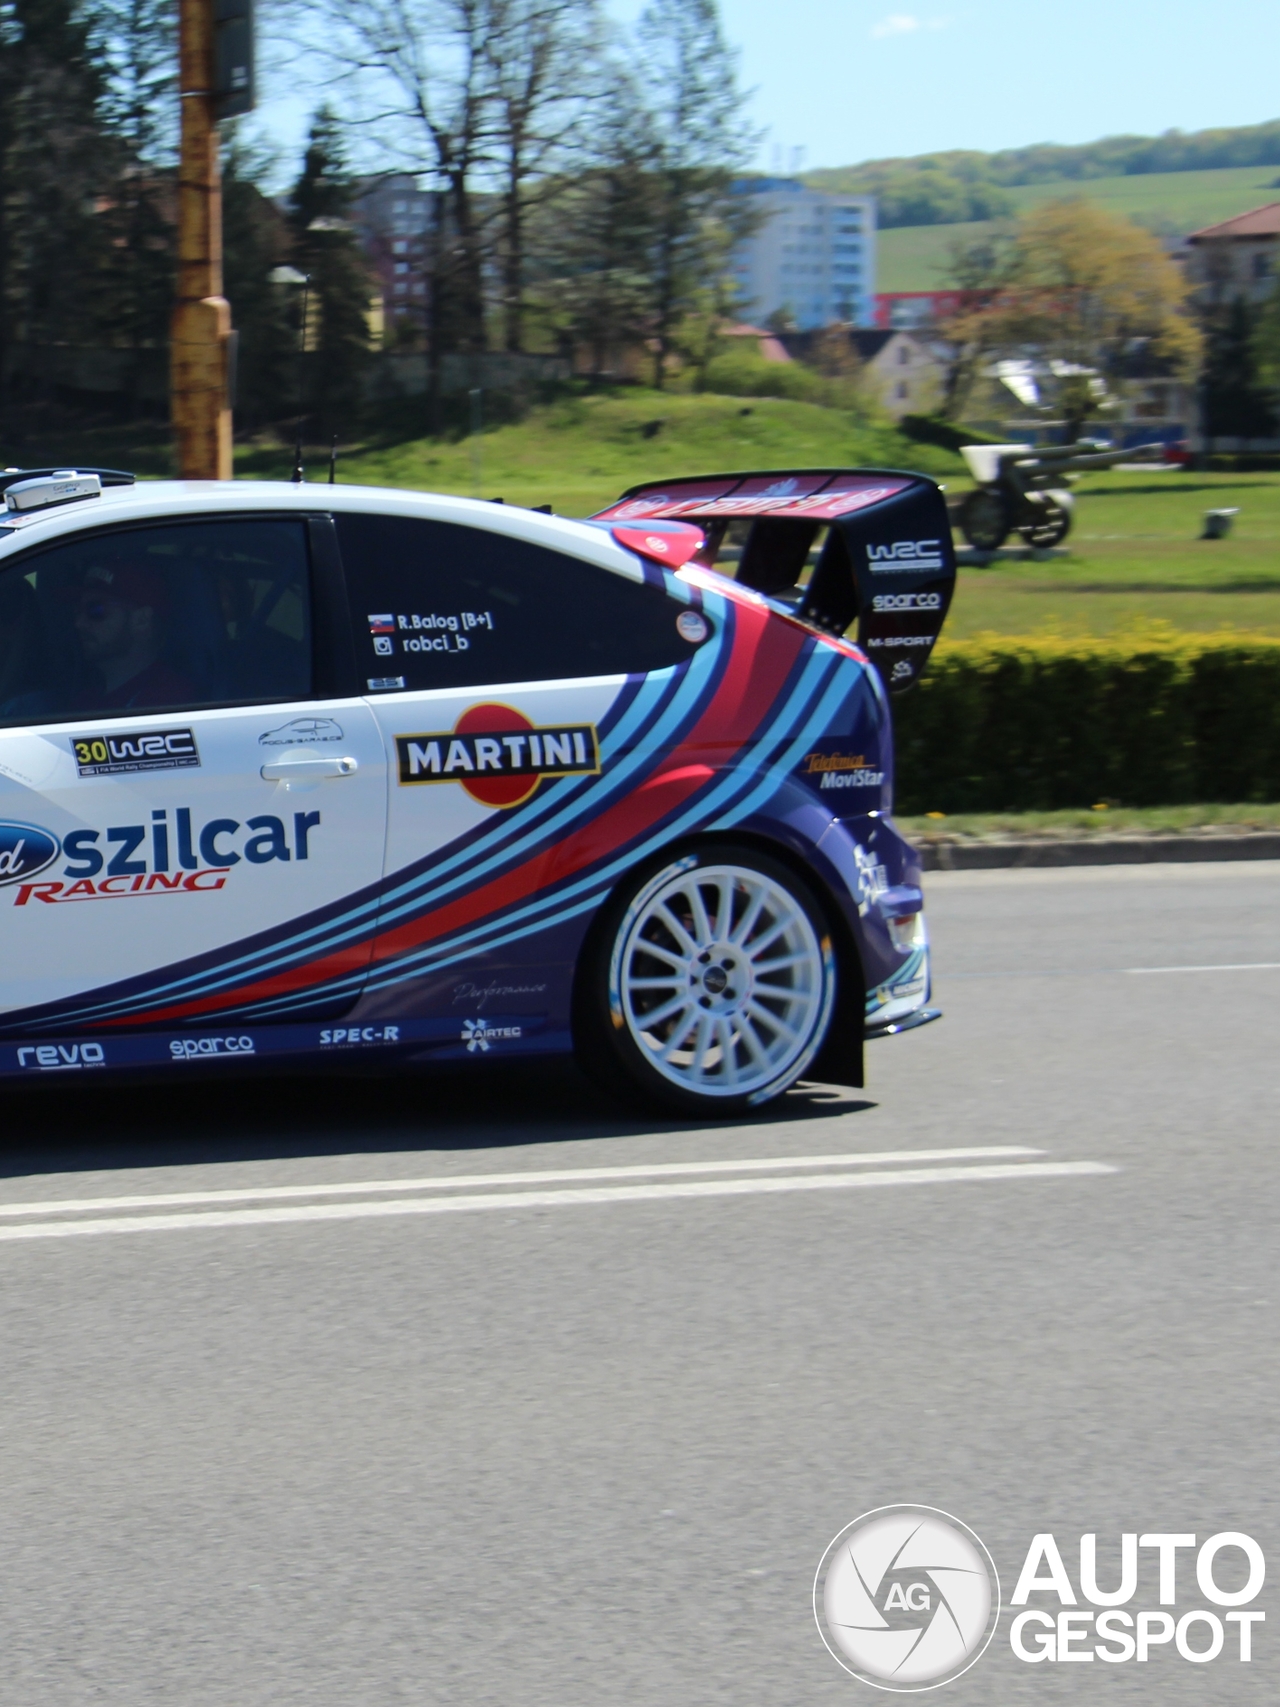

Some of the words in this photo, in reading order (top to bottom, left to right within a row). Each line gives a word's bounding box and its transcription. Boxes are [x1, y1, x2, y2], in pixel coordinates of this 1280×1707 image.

[866, 540, 941, 560] WRC
[872, 593, 941, 612] sparco
[397, 613, 460, 632] R.Balog
[460, 611, 494, 631] [B+]
[402, 634, 469, 653] robci_b
[867, 636, 934, 648] M-SPORT
[75, 741, 107, 763] 30
[109, 733, 194, 759] WRC
[406, 731, 587, 776] MARTINI
[819, 769, 885, 789] MoviStar
[62, 808, 321, 878] szilcar
[13, 868, 230, 906] RACING
[319, 1026, 399, 1044] SPEC-R
[474, 1027, 522, 1038] AIRTEC
[17, 1043, 104, 1067] revo
[169, 1036, 254, 1059] sparco
